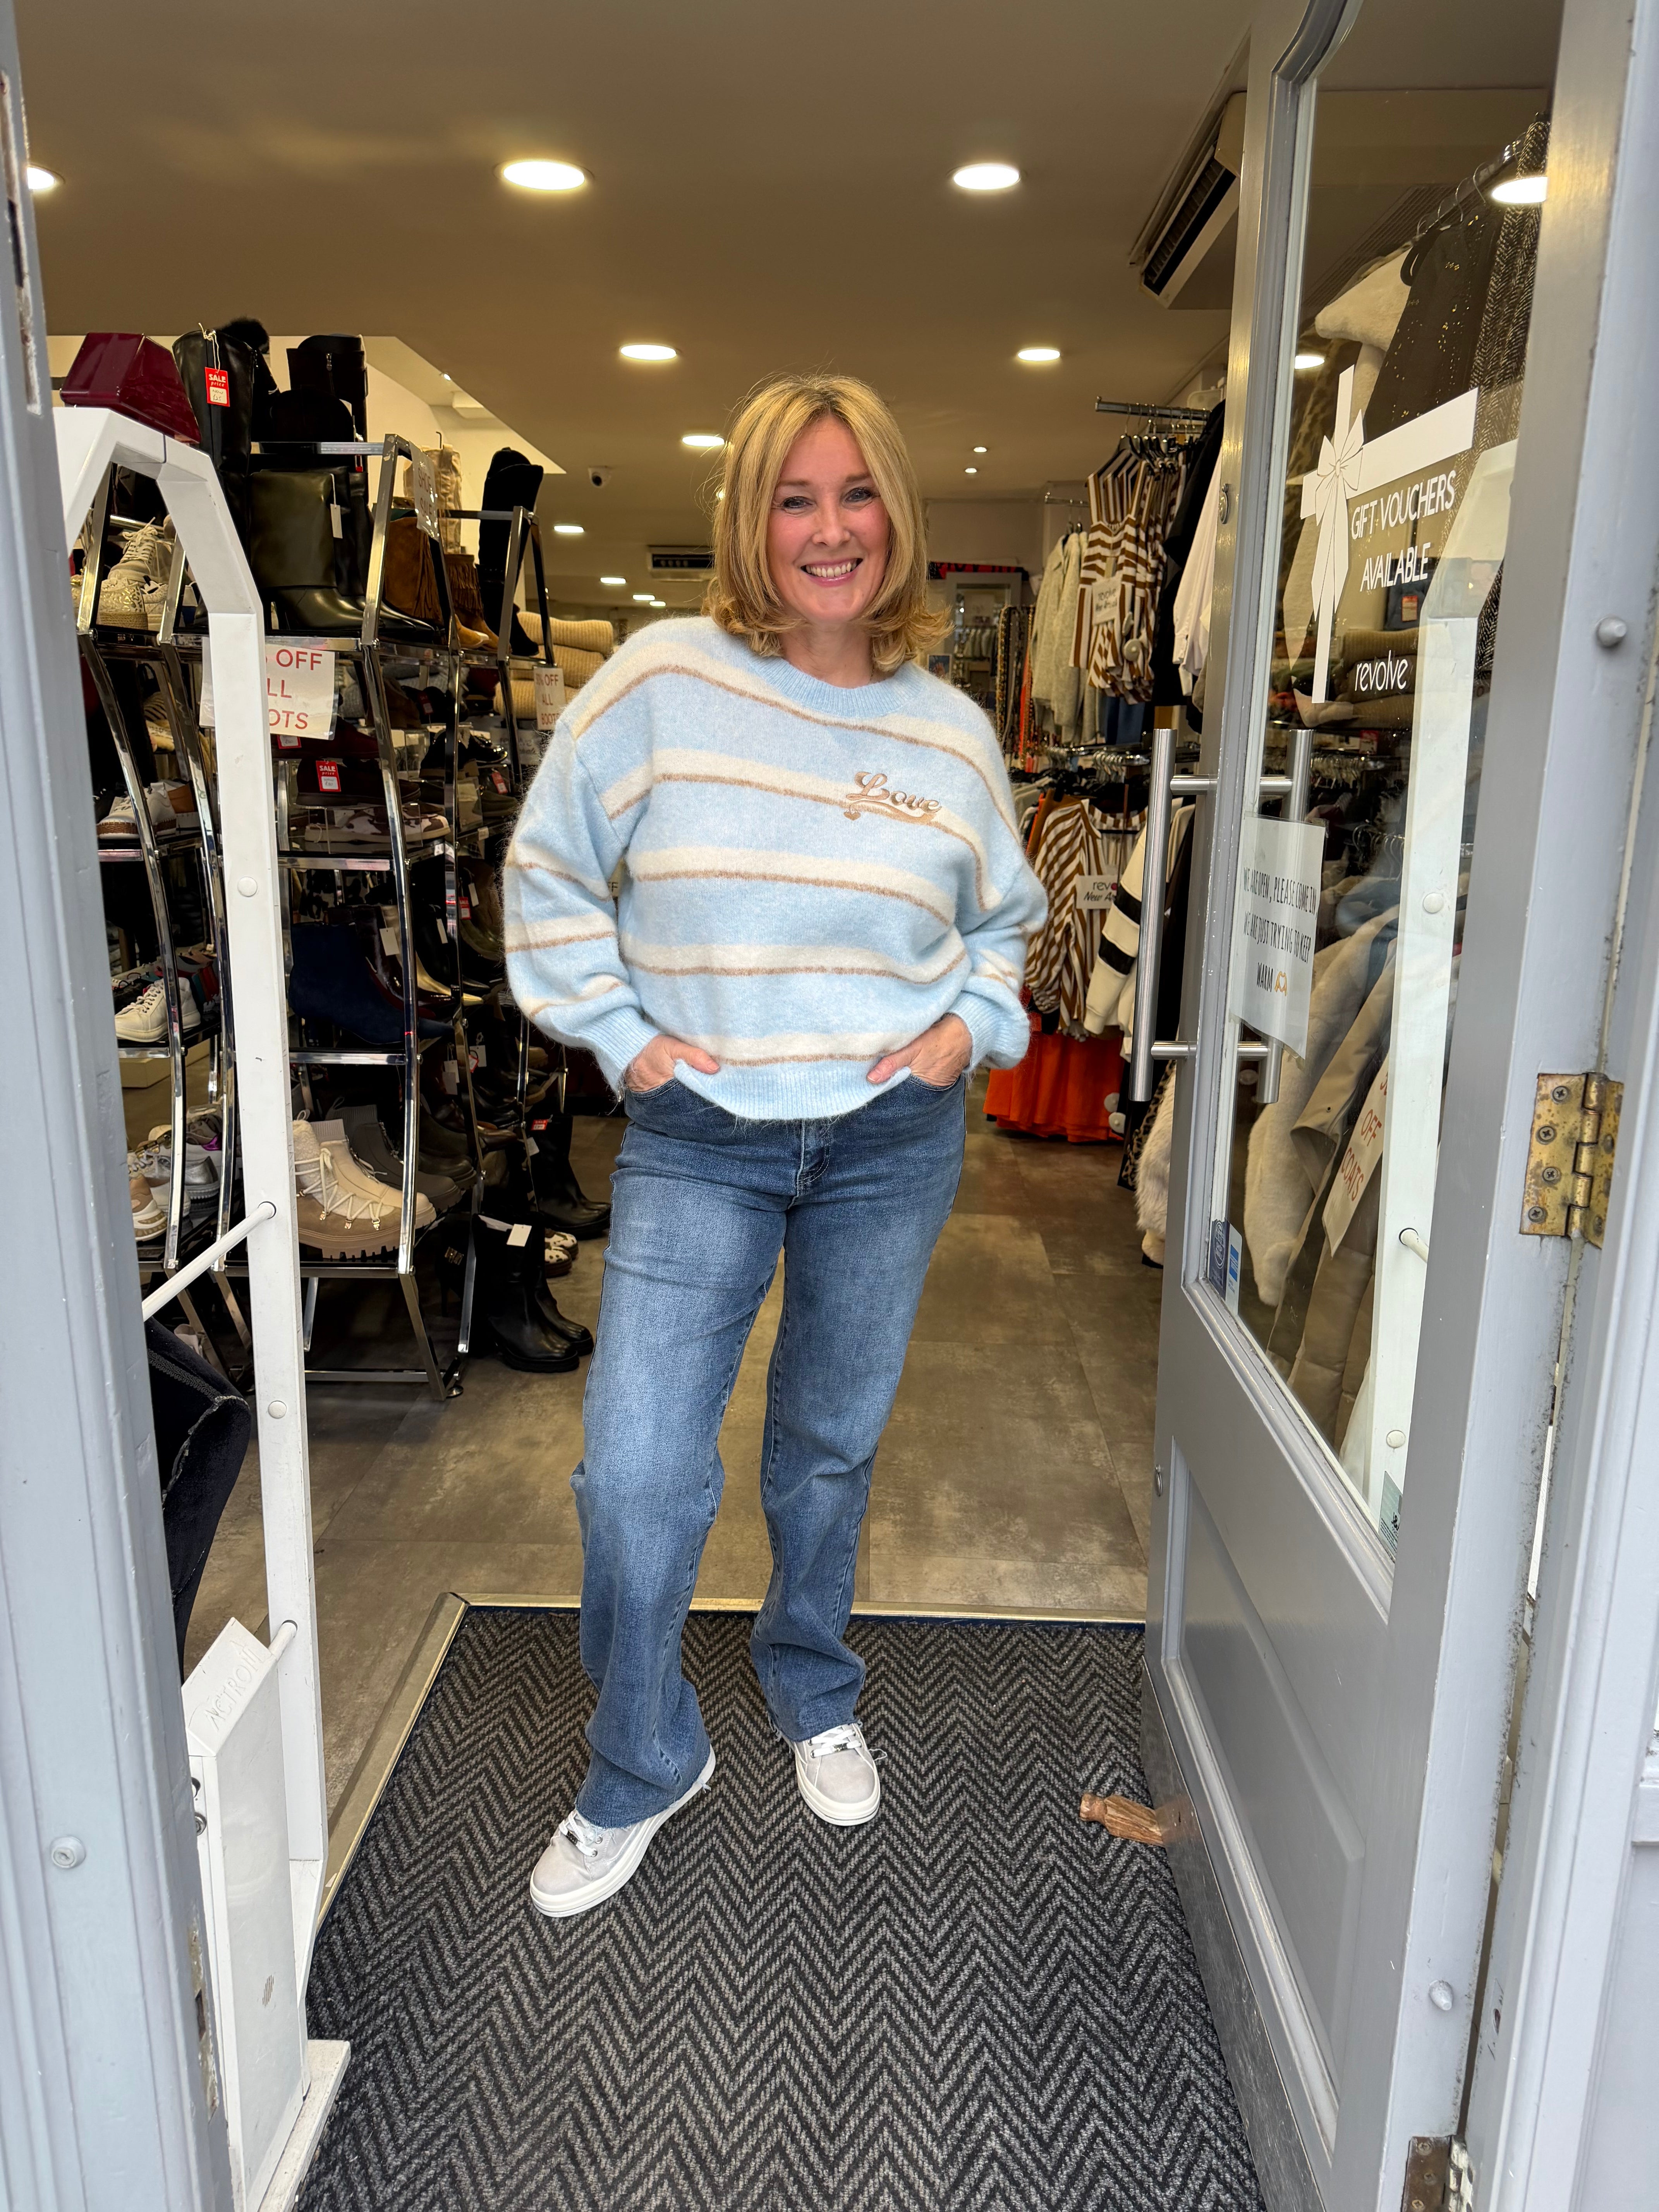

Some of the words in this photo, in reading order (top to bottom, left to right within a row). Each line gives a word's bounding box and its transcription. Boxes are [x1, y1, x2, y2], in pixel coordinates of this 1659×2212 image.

[209, 374, 226, 383] SALE
[1352, 500, 1378, 539] GIFT
[1380, 470, 1456, 530] VOUCHERS
[1360, 542, 1431, 592] AVAILABLE
[276, 649, 322, 671] OFF
[544, 674, 559, 686] OFF
[1355, 650, 1408, 692] revolve
[267, 678, 292, 699] LL
[268, 709, 309, 730] OTS
[846, 771, 942, 814] Love
[1243, 867, 1250, 892] WE
[1250, 869, 1259, 895] ARE
[1273, 876, 1296, 907] PLEASE
[1295, 882, 1309, 912] COME
[1243, 910, 1251, 936] WE
[1250, 913, 1258, 940] ARE
[1257, 917, 1269, 945] JUST
[1270, 921, 1293, 953] TRYING
[1293, 929, 1300, 957] TO
[1299, 933, 1312, 964] KEEP
[1257, 962, 1273, 993] WARM
[1361, 1108, 1382, 1147] OFF
[1341, 1146, 1364, 1202] COATS
